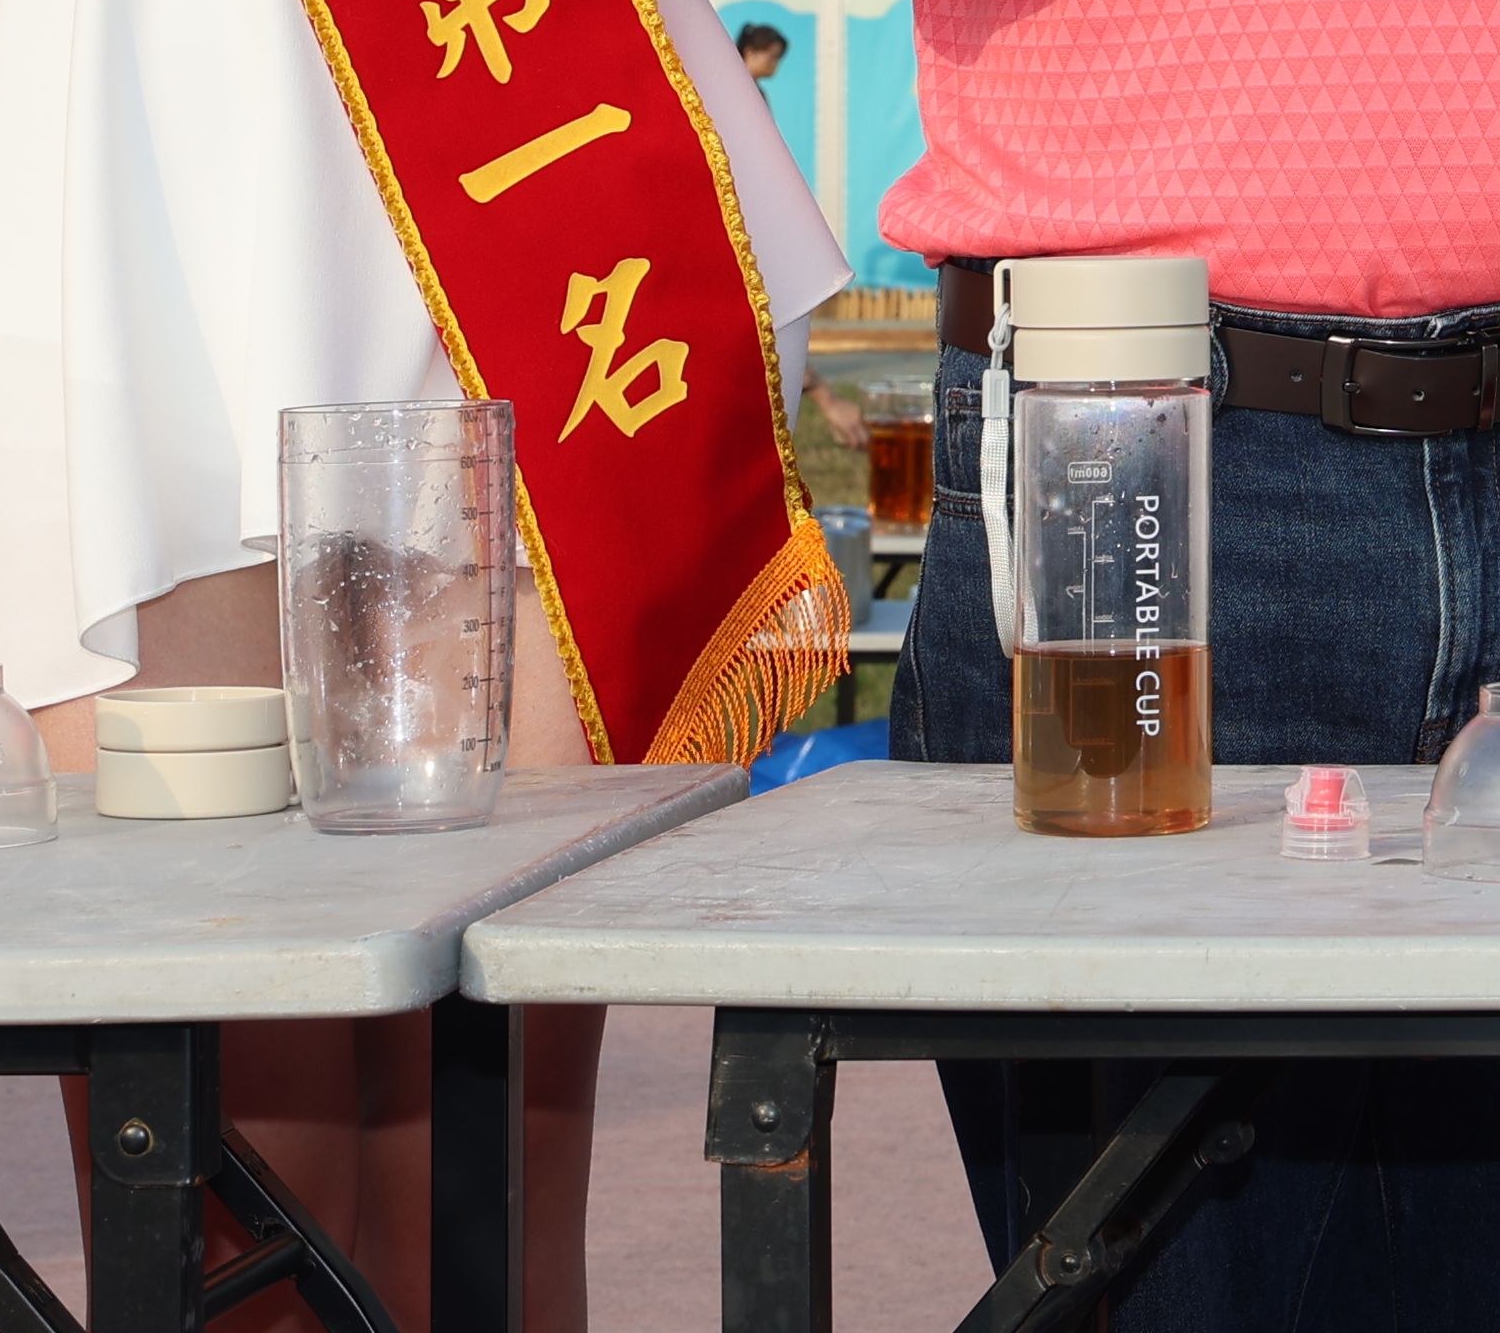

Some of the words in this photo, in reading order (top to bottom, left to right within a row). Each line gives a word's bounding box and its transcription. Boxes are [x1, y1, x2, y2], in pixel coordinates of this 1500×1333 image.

[460, 457, 477, 468] 600
[461, 508, 477, 520] 500
[1135, 495, 1160, 661] PORTABLE
[463, 619, 479, 633] 300
[1135, 671, 1160, 736] CUP
[460, 738, 476, 751] 100
